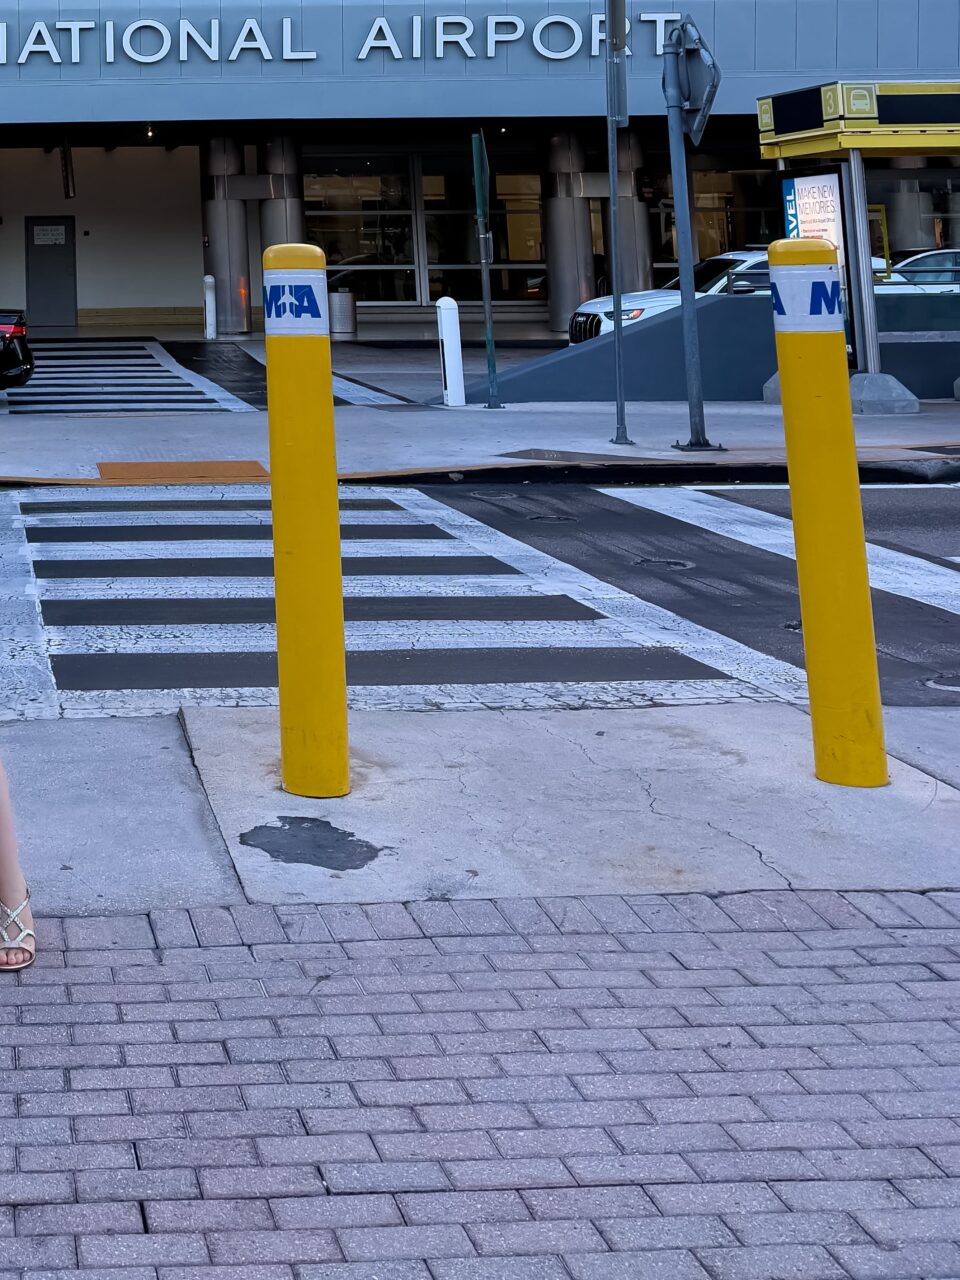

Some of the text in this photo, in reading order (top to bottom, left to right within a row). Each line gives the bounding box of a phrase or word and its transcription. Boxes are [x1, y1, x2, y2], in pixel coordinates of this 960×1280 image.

[357, 12, 682, 59] AIRPORT
[826, 91, 835, 114] 3
[797, 184, 835, 201] MAKE NEW
